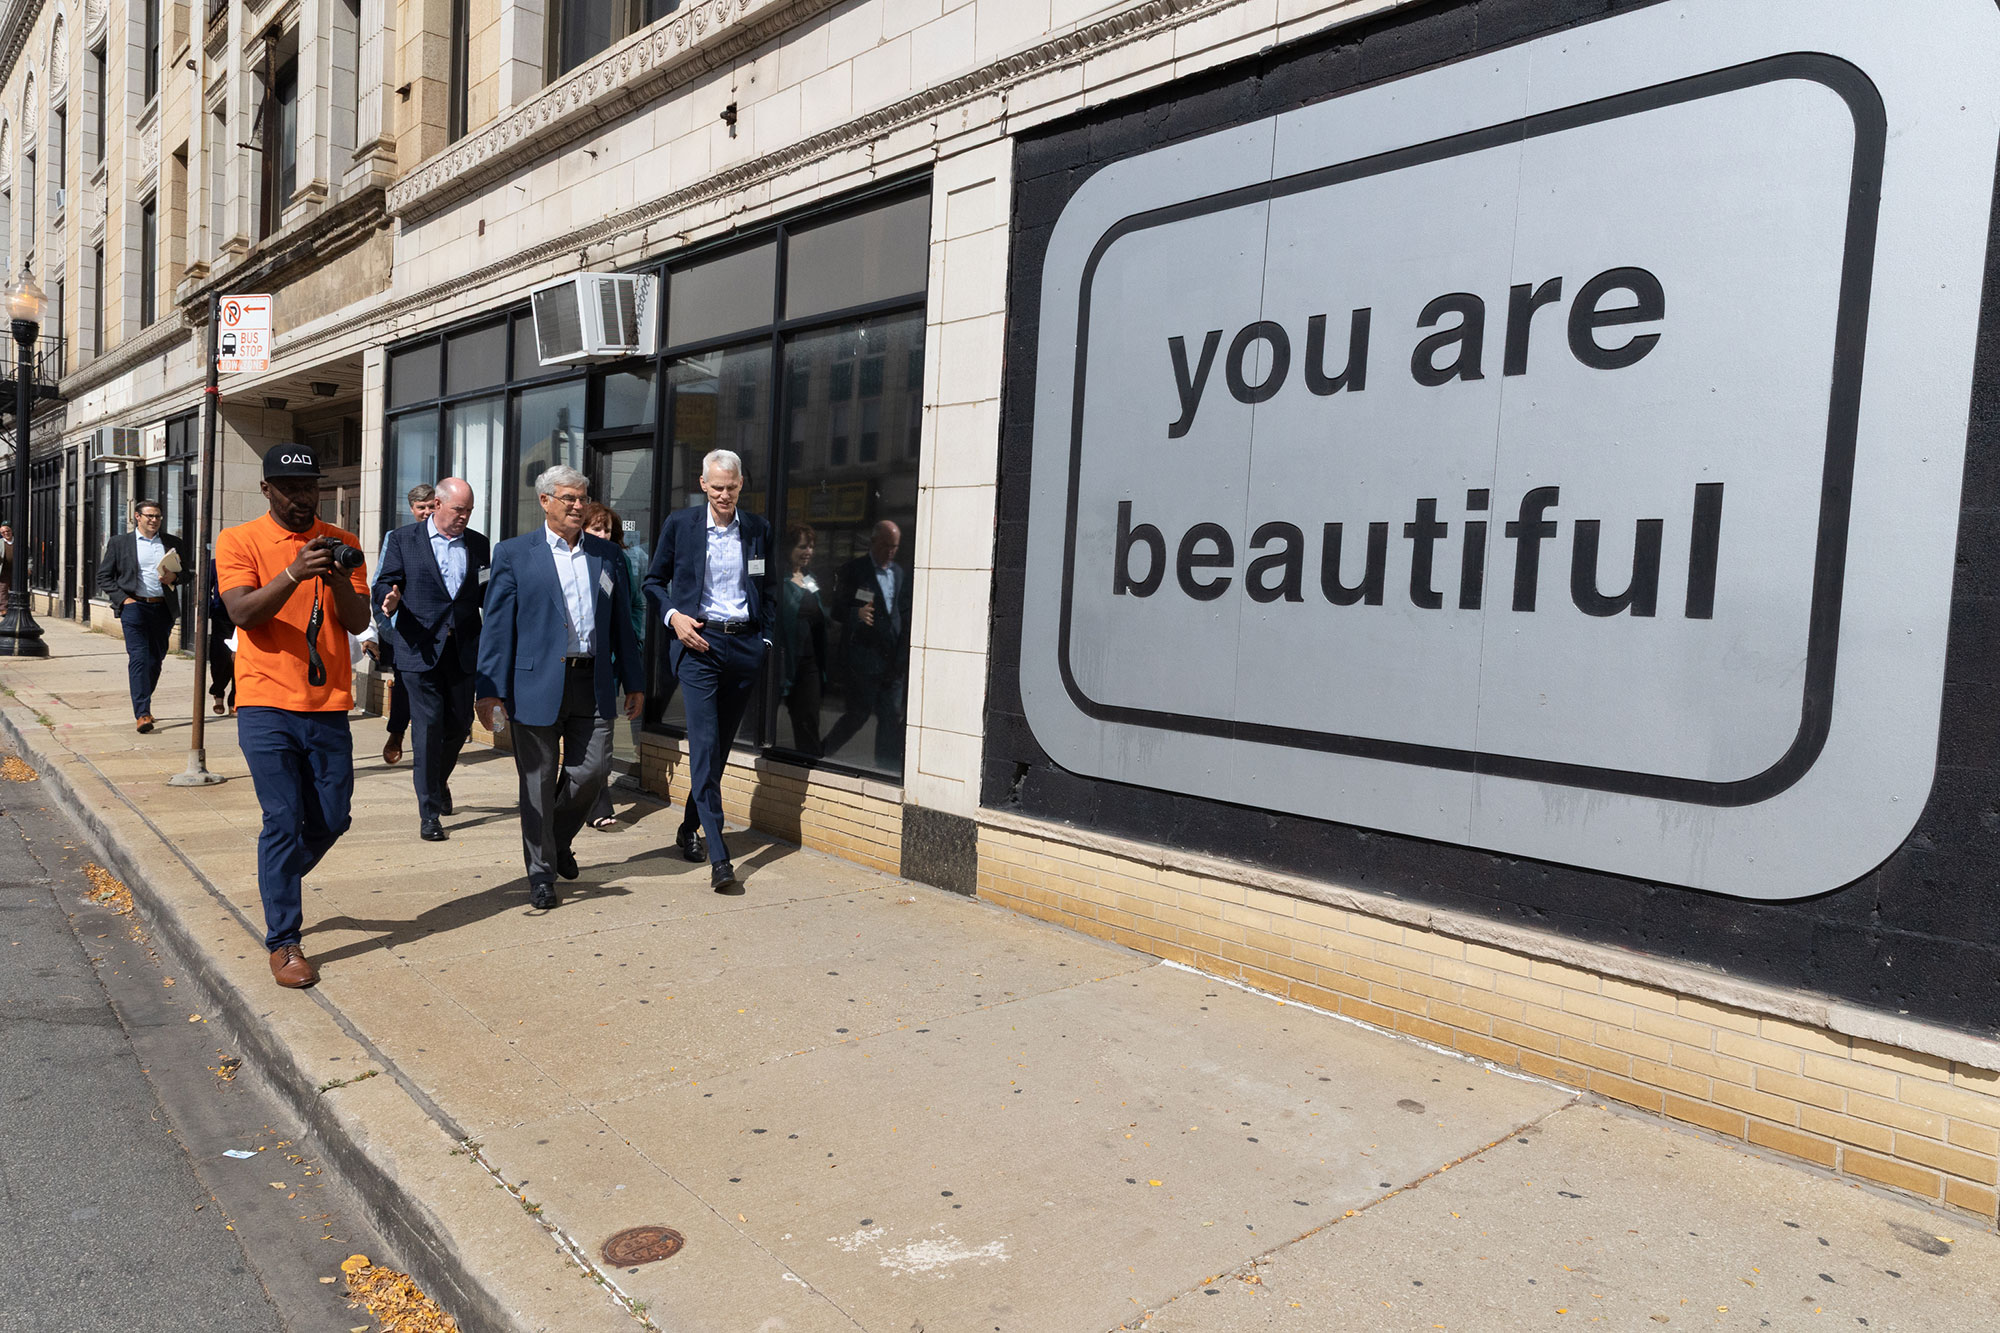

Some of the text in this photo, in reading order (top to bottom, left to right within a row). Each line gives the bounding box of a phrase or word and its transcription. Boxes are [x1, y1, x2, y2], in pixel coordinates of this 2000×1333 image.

[241, 332, 258, 344] BUS
[239, 345, 263, 357] STOP
[1166, 266, 1667, 439] you are
[221, 360, 238, 371] TOW
[1112, 482, 1726, 620] beautiful
